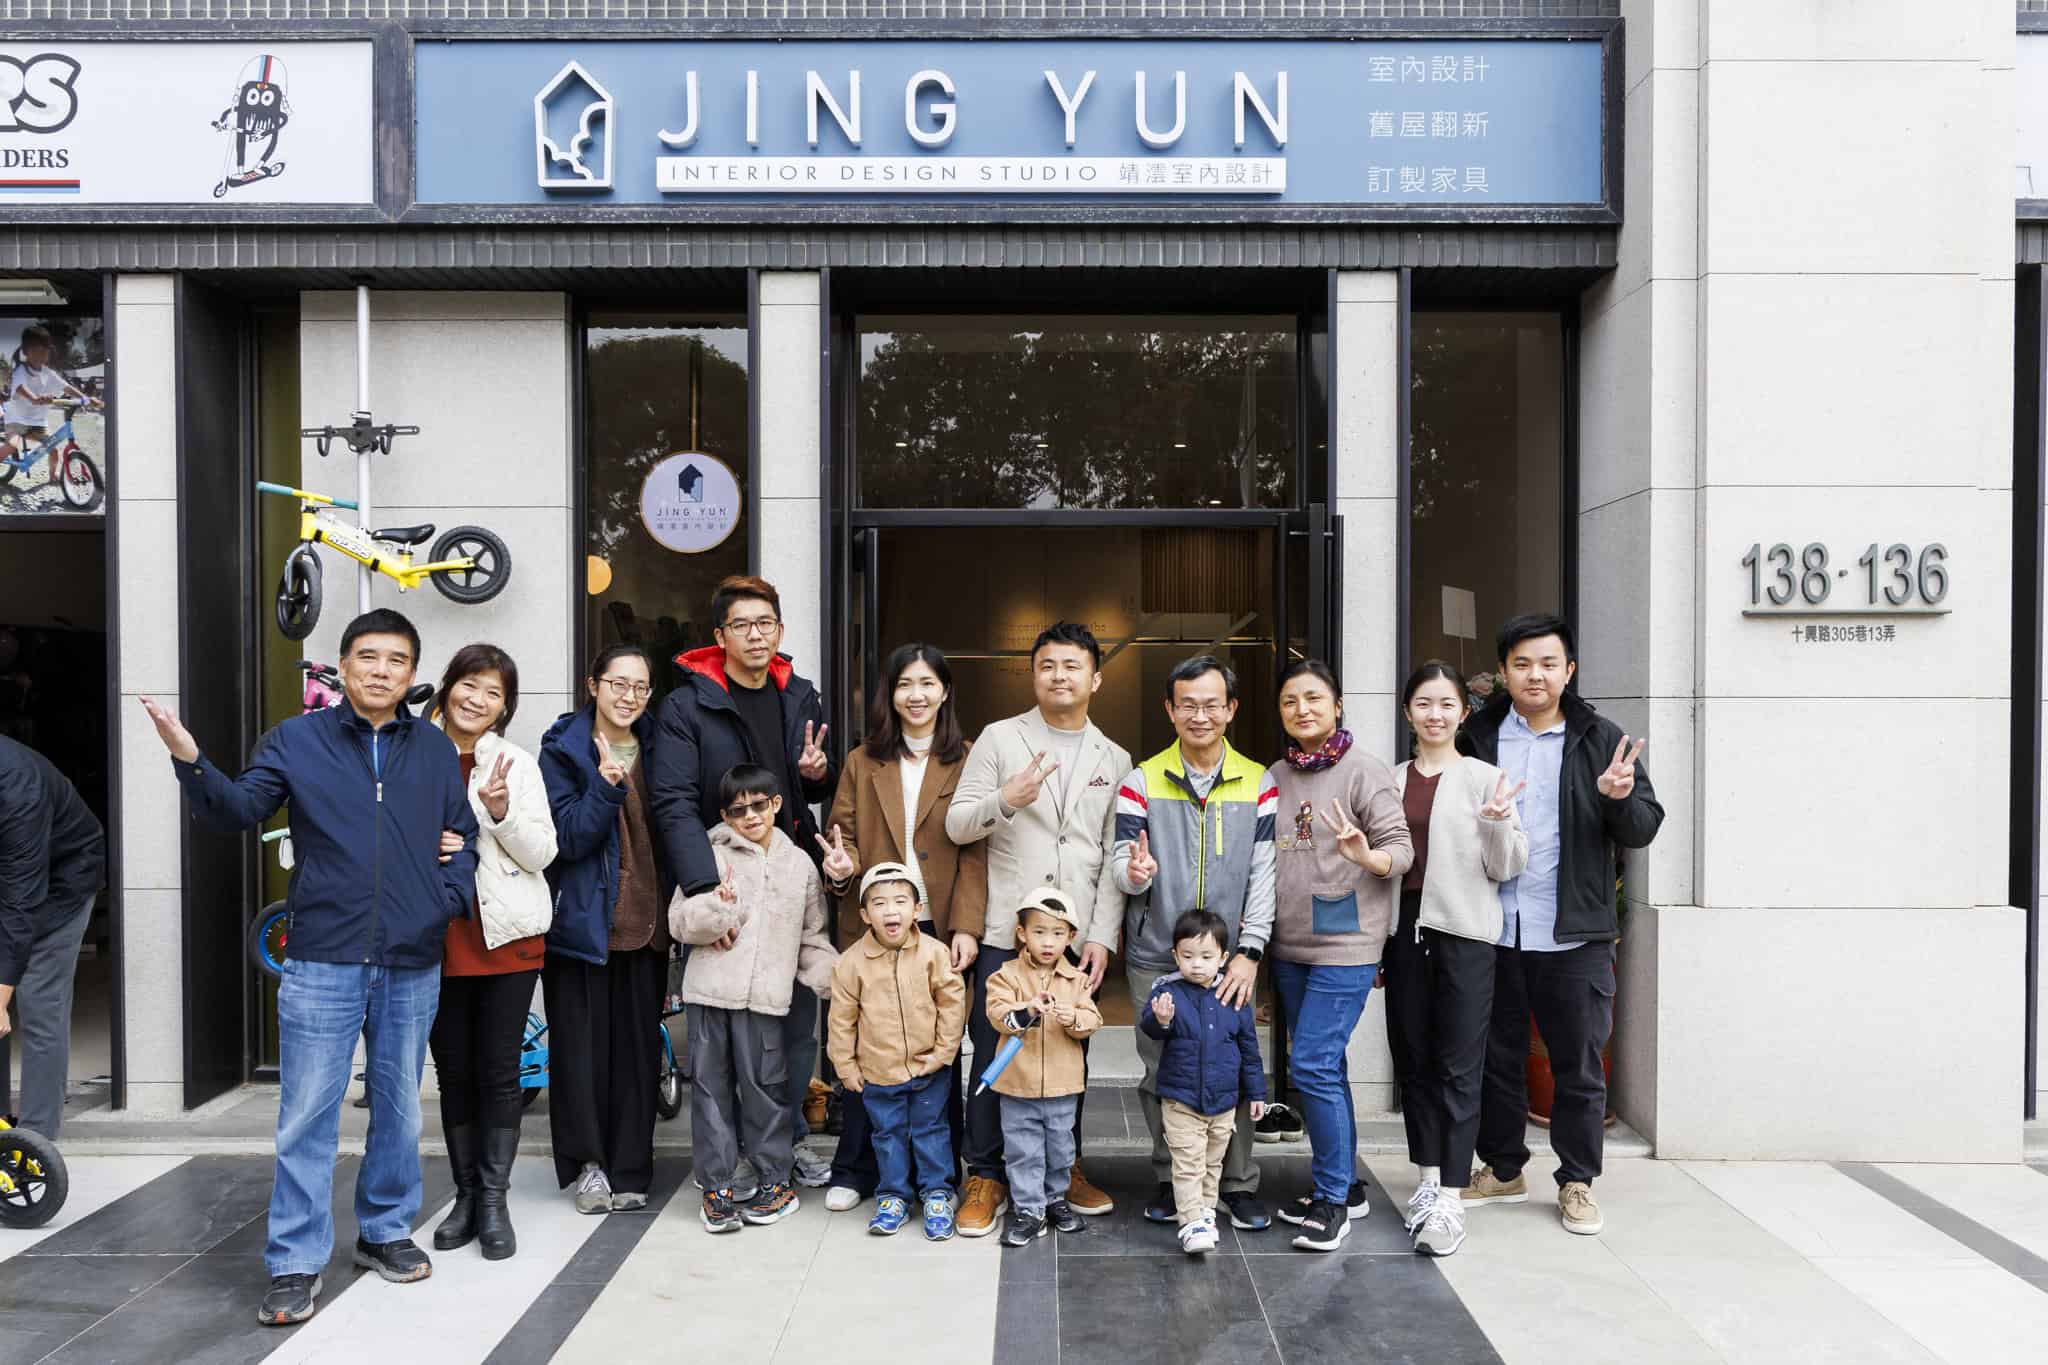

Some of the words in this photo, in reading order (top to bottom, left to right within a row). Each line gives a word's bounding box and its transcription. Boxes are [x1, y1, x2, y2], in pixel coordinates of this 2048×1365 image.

[1367, 55, 1490, 83] 室內設計
[656, 69, 958, 149] JING
[1044, 69, 1288, 150] YUN
[1367, 110, 1490, 138] 舊屋翻新
[0, 148, 69, 168] DERS
[671, 164, 819, 182] INTERIOR
[840, 164, 958, 182] DESIGN
[980, 165, 1098, 182] STUDIO
[1367, 166, 1489, 193] 訂製家具
[656, 507, 690, 517] JING
[699, 507, 727, 517] YUN
